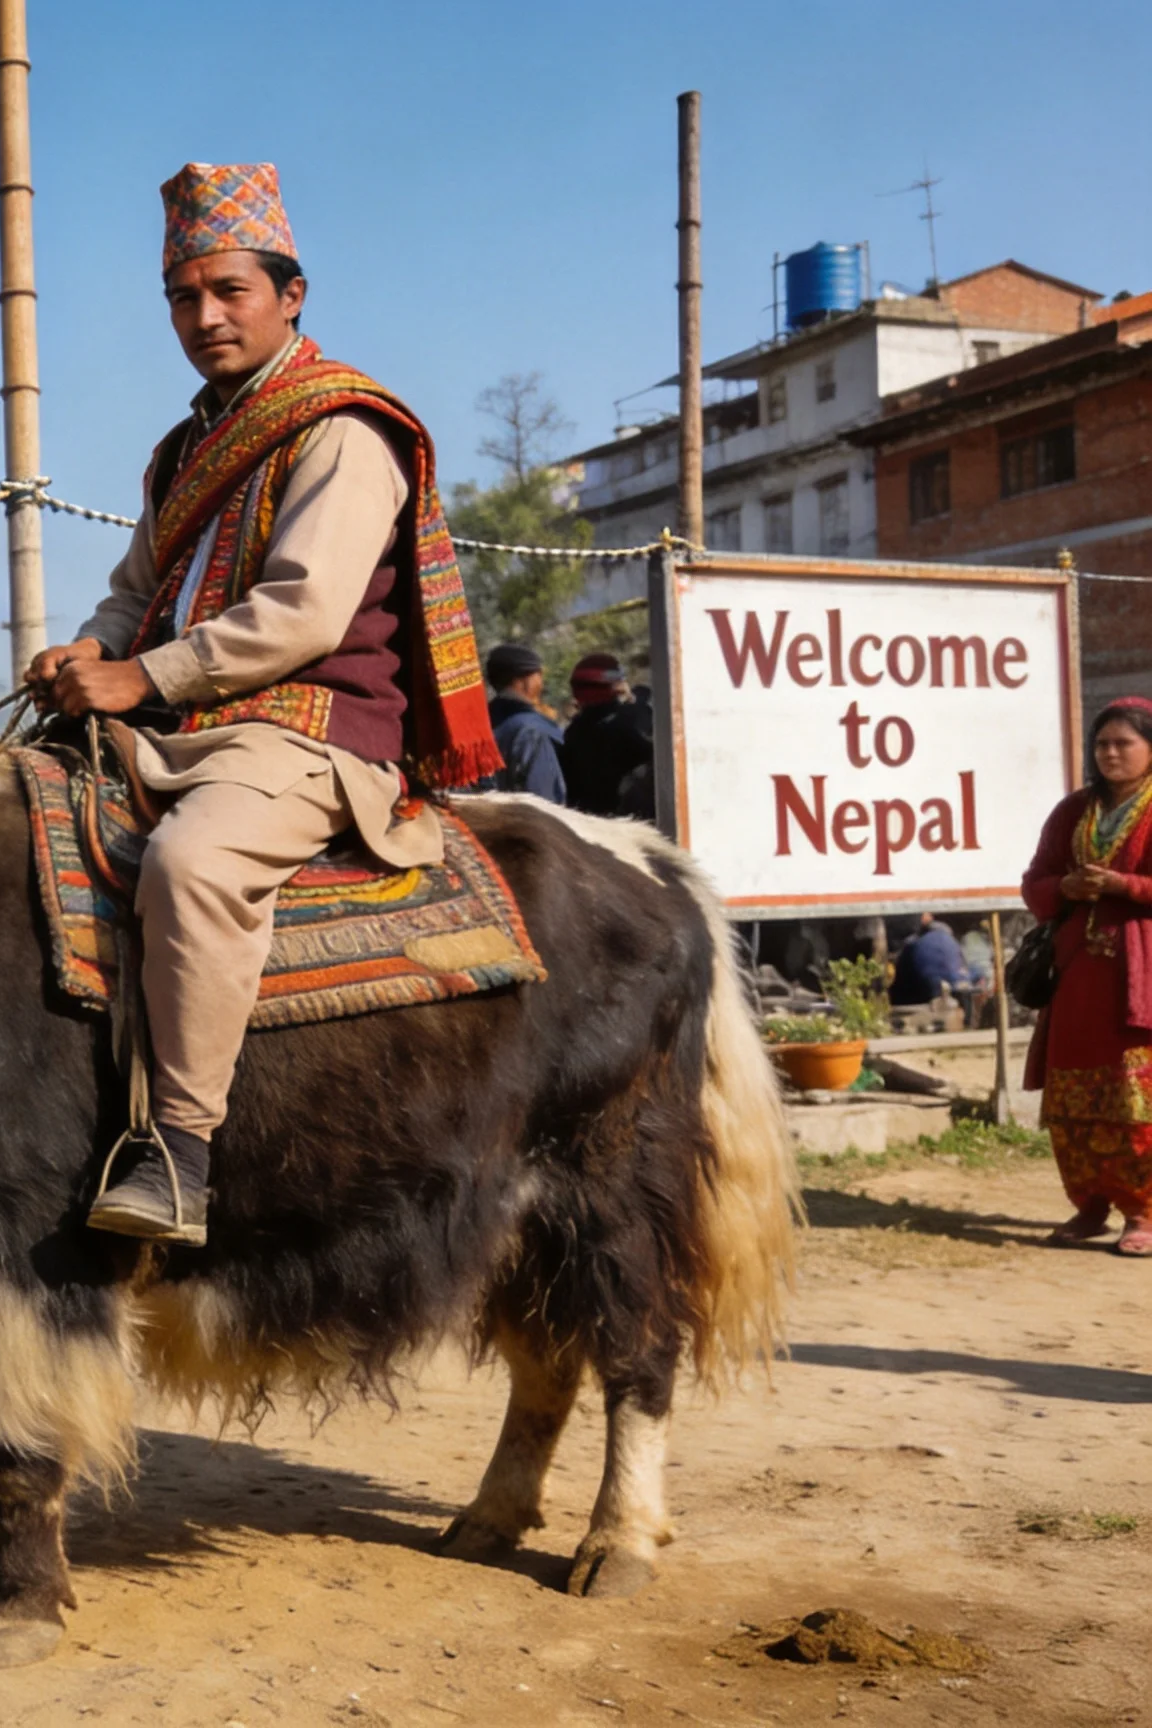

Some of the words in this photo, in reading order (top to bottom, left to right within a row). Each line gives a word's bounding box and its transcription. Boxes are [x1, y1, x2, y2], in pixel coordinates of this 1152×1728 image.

[705, 608, 1028, 688] Welcome
[839, 701, 915, 769] to
[770, 770, 981, 876] Nepal
